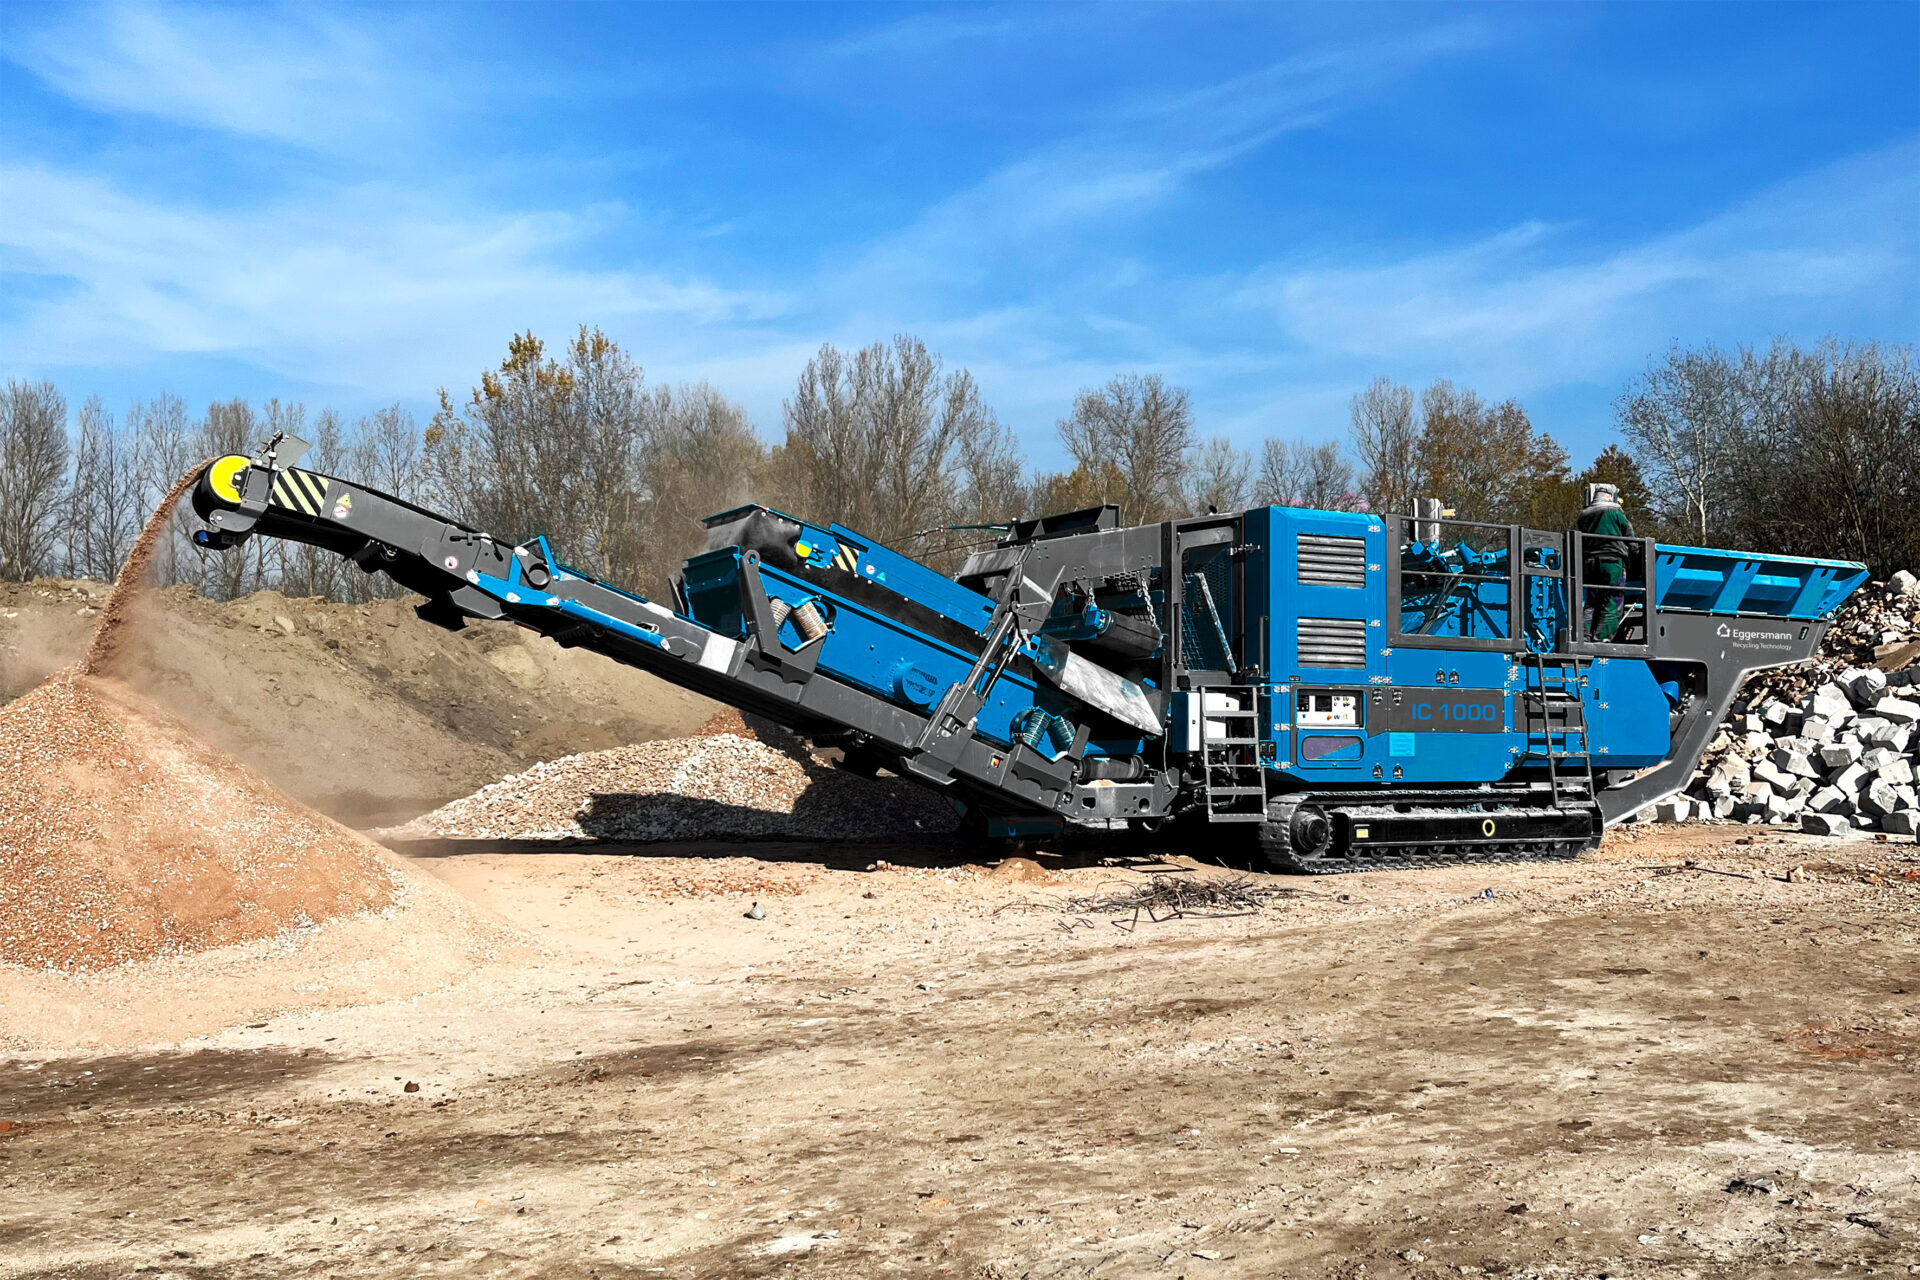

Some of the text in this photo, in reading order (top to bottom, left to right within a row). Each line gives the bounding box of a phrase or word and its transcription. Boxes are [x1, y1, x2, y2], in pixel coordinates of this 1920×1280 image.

[1732, 629, 1793, 641] Eggersmann
[1732, 642, 1792, 651] Recycling Technology
[1412, 703, 1497, 721] IC 1000
